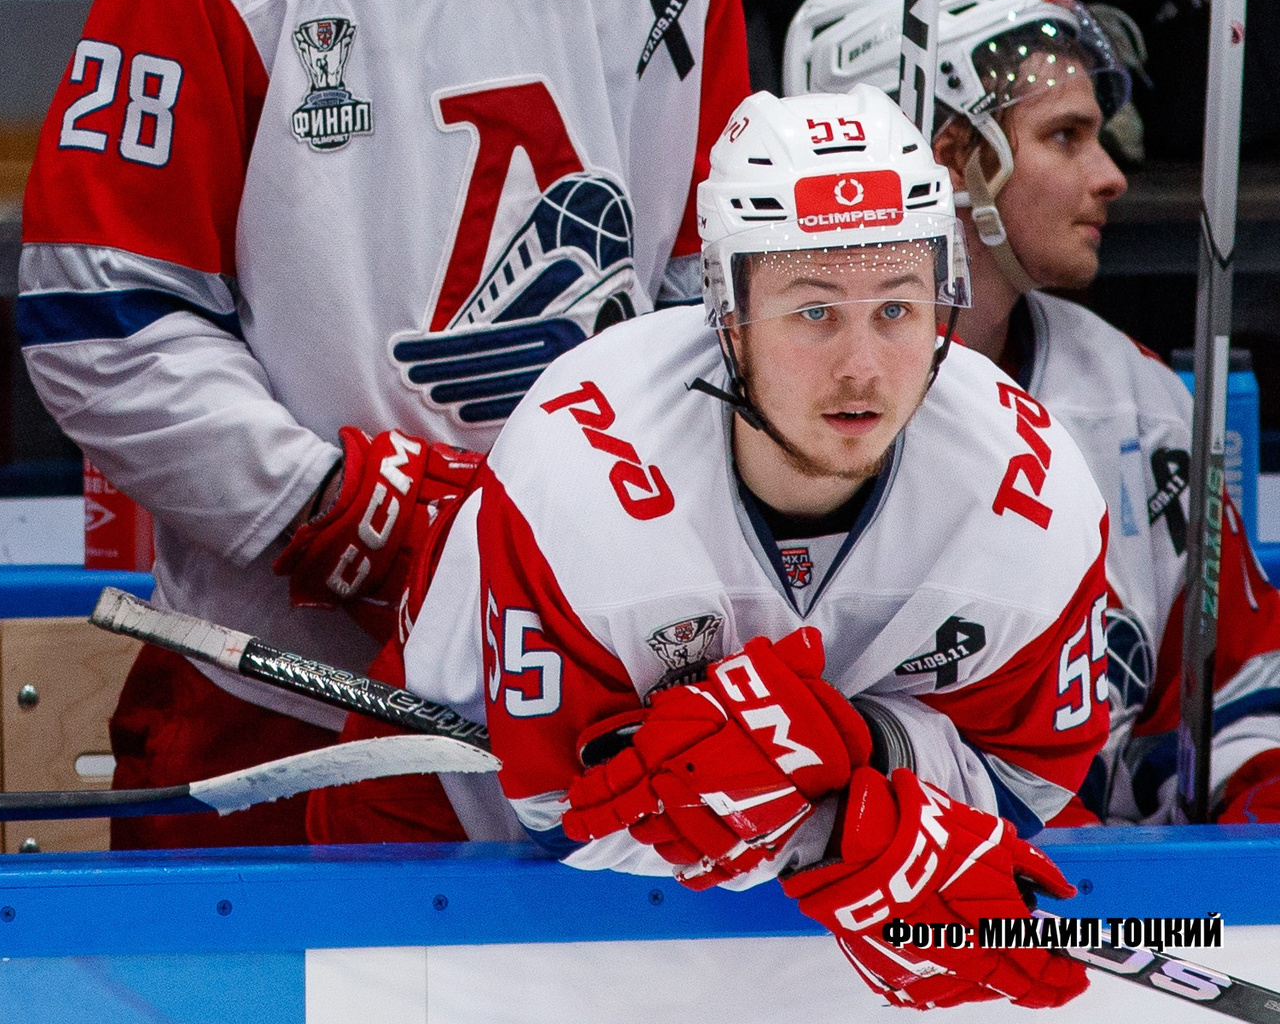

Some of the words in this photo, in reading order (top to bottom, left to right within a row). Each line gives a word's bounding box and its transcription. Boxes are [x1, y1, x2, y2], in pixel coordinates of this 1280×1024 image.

[58, 39, 183, 169] 28
[293, 104, 370, 137] ФИНАЛ
[806, 118, 866, 144] 55
[804, 208, 899, 227] OLIMPBET
[326, 428, 422, 597] CCM
[903, 646, 971, 674] 07.09.11
[834, 786, 952, 932] CCM
